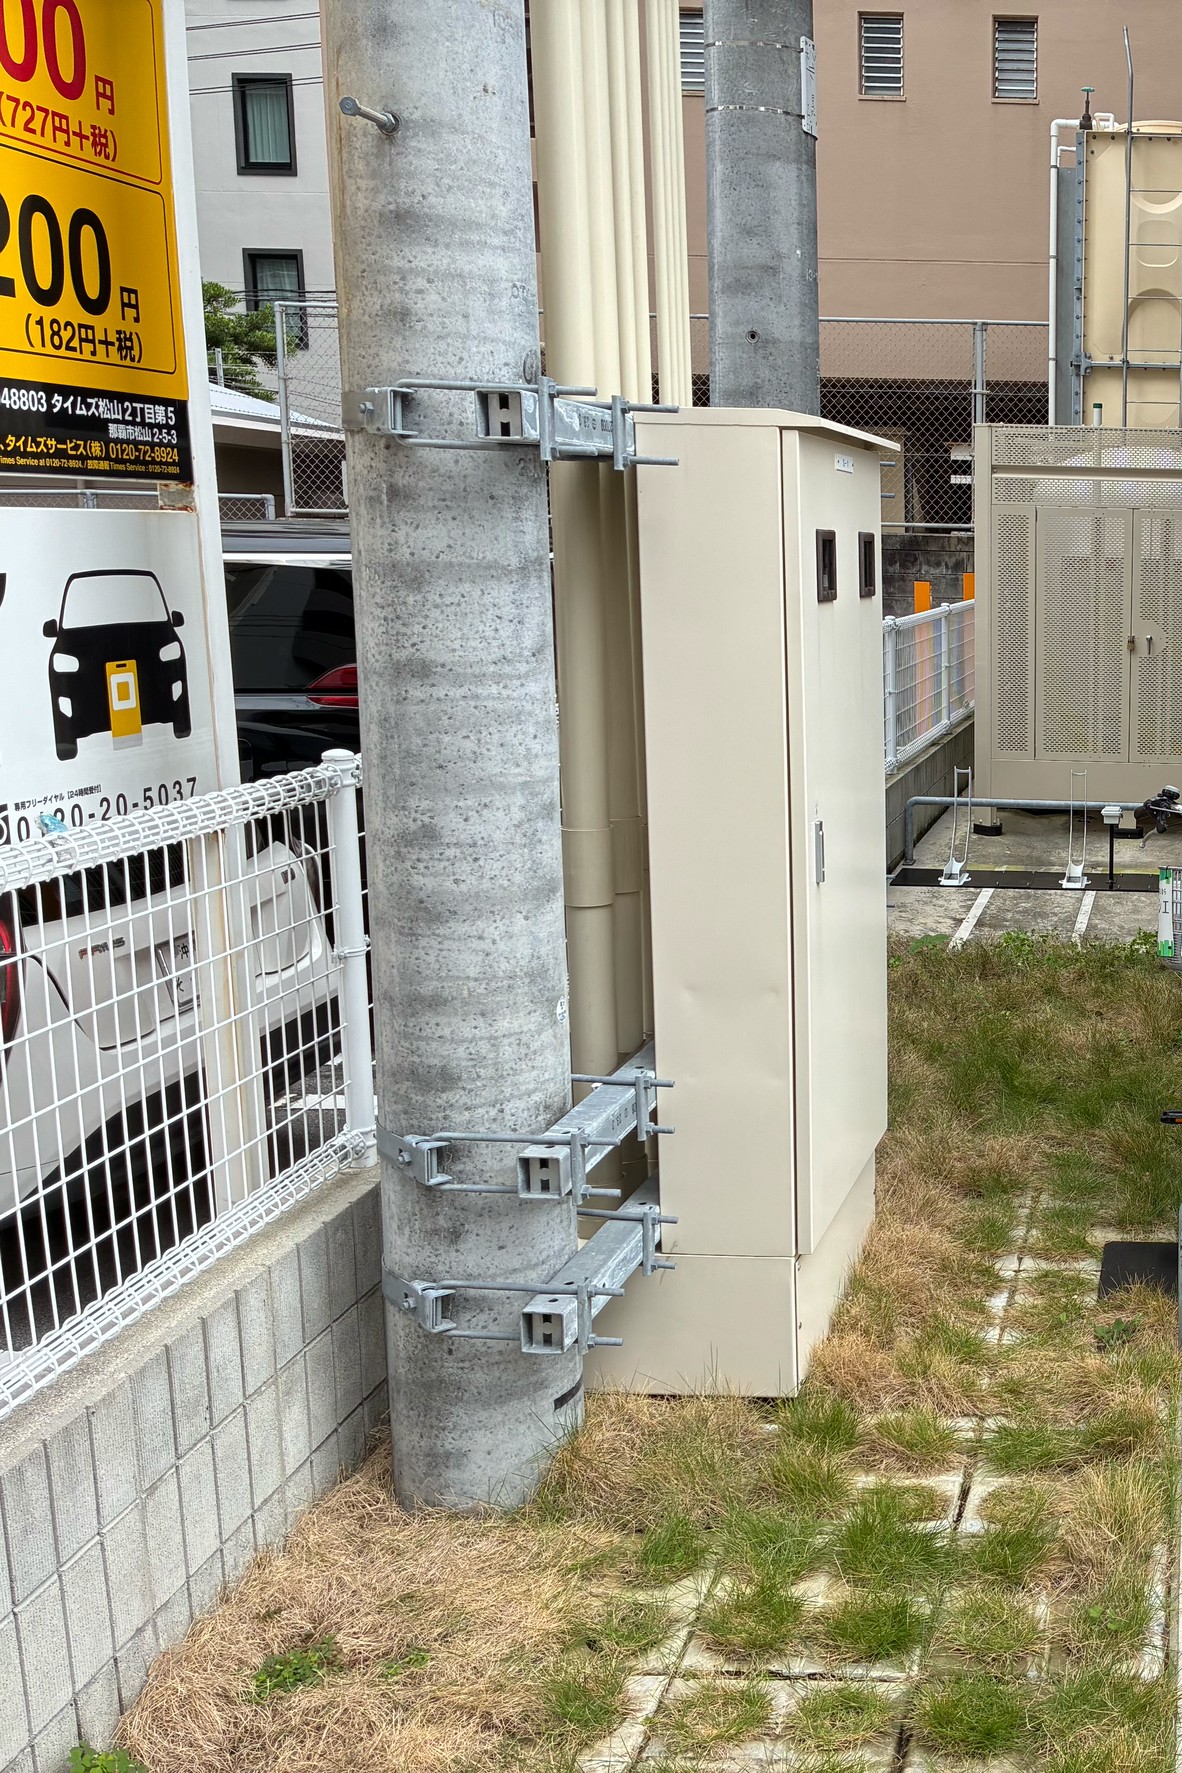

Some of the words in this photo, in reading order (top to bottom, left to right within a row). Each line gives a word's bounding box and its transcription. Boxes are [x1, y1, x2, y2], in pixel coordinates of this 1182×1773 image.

[0, 387, 47, 412] 48803
[153, 427, 178, 444] 2-5-3
[109, 443, 179, 463] 0120-72-8924
